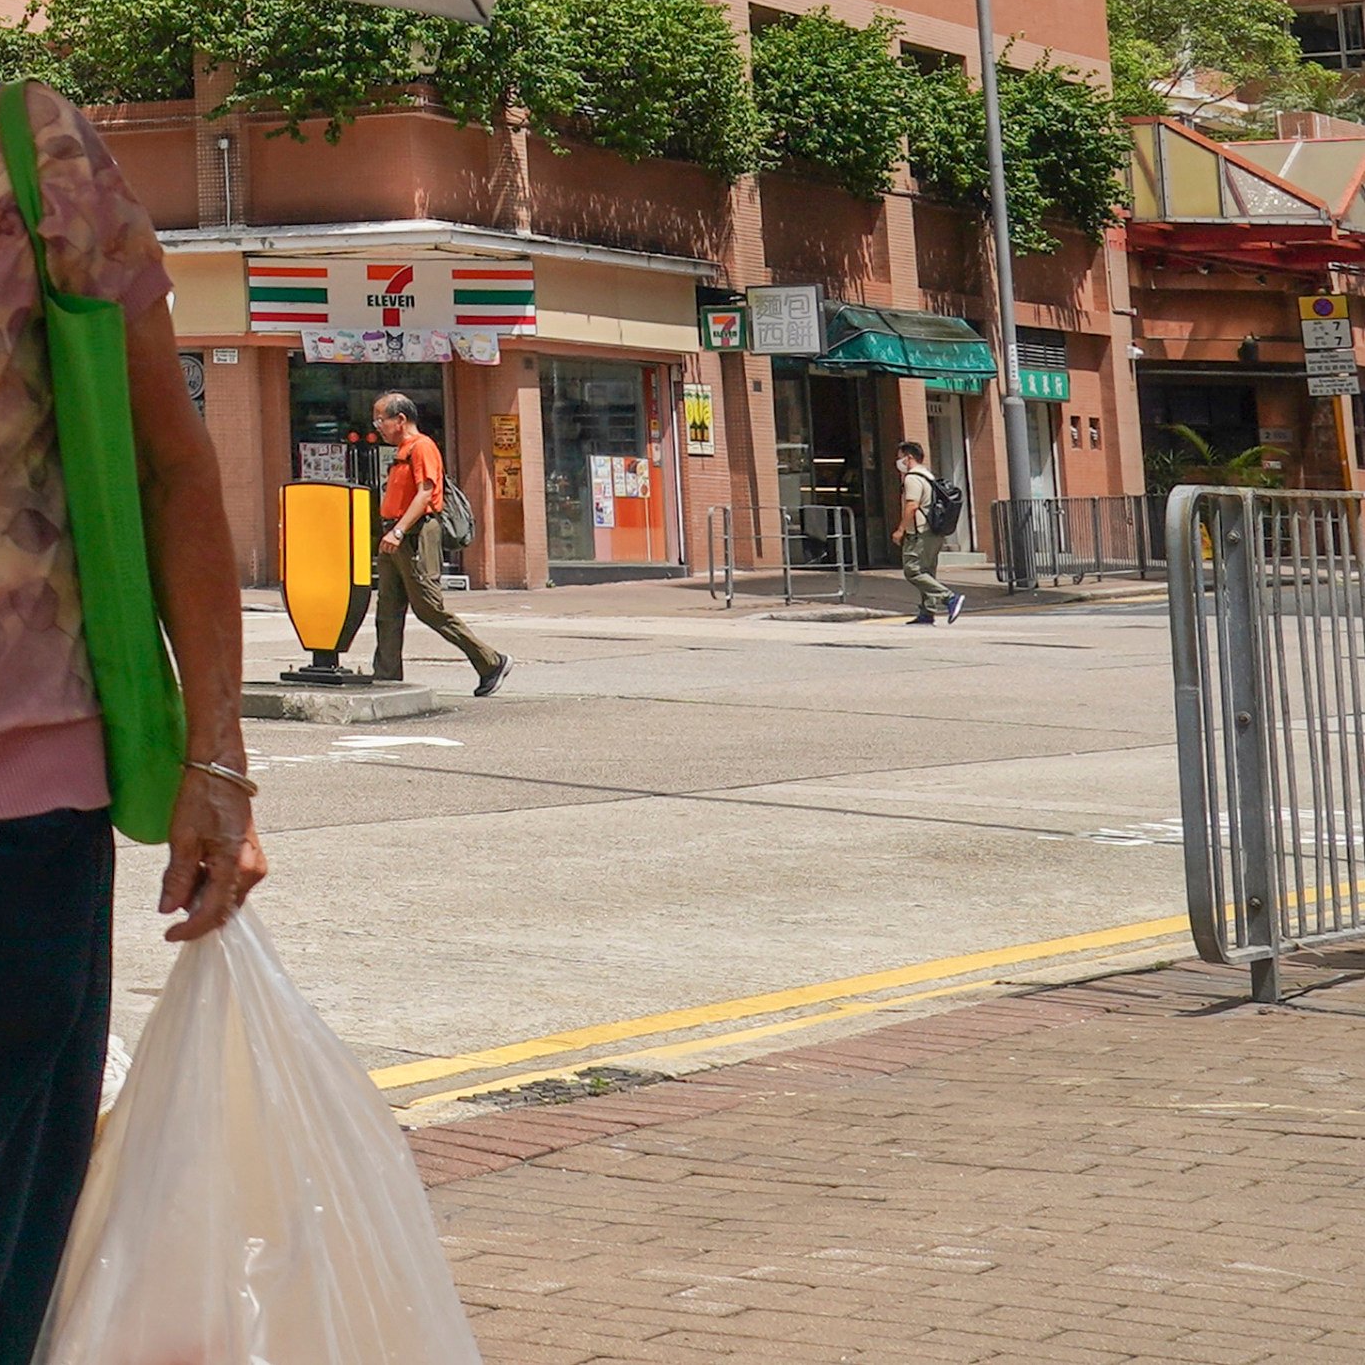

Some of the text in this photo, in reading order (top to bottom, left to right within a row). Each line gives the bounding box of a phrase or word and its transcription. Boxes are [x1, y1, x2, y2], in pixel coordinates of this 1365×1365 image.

[367, 265, 413, 327] 7
[712, 316, 736, 347] 7
[757, 321, 814, 348] 西餅
[1332, 321, 1341, 331] 7
[1334, 336, 1343, 346] 7
